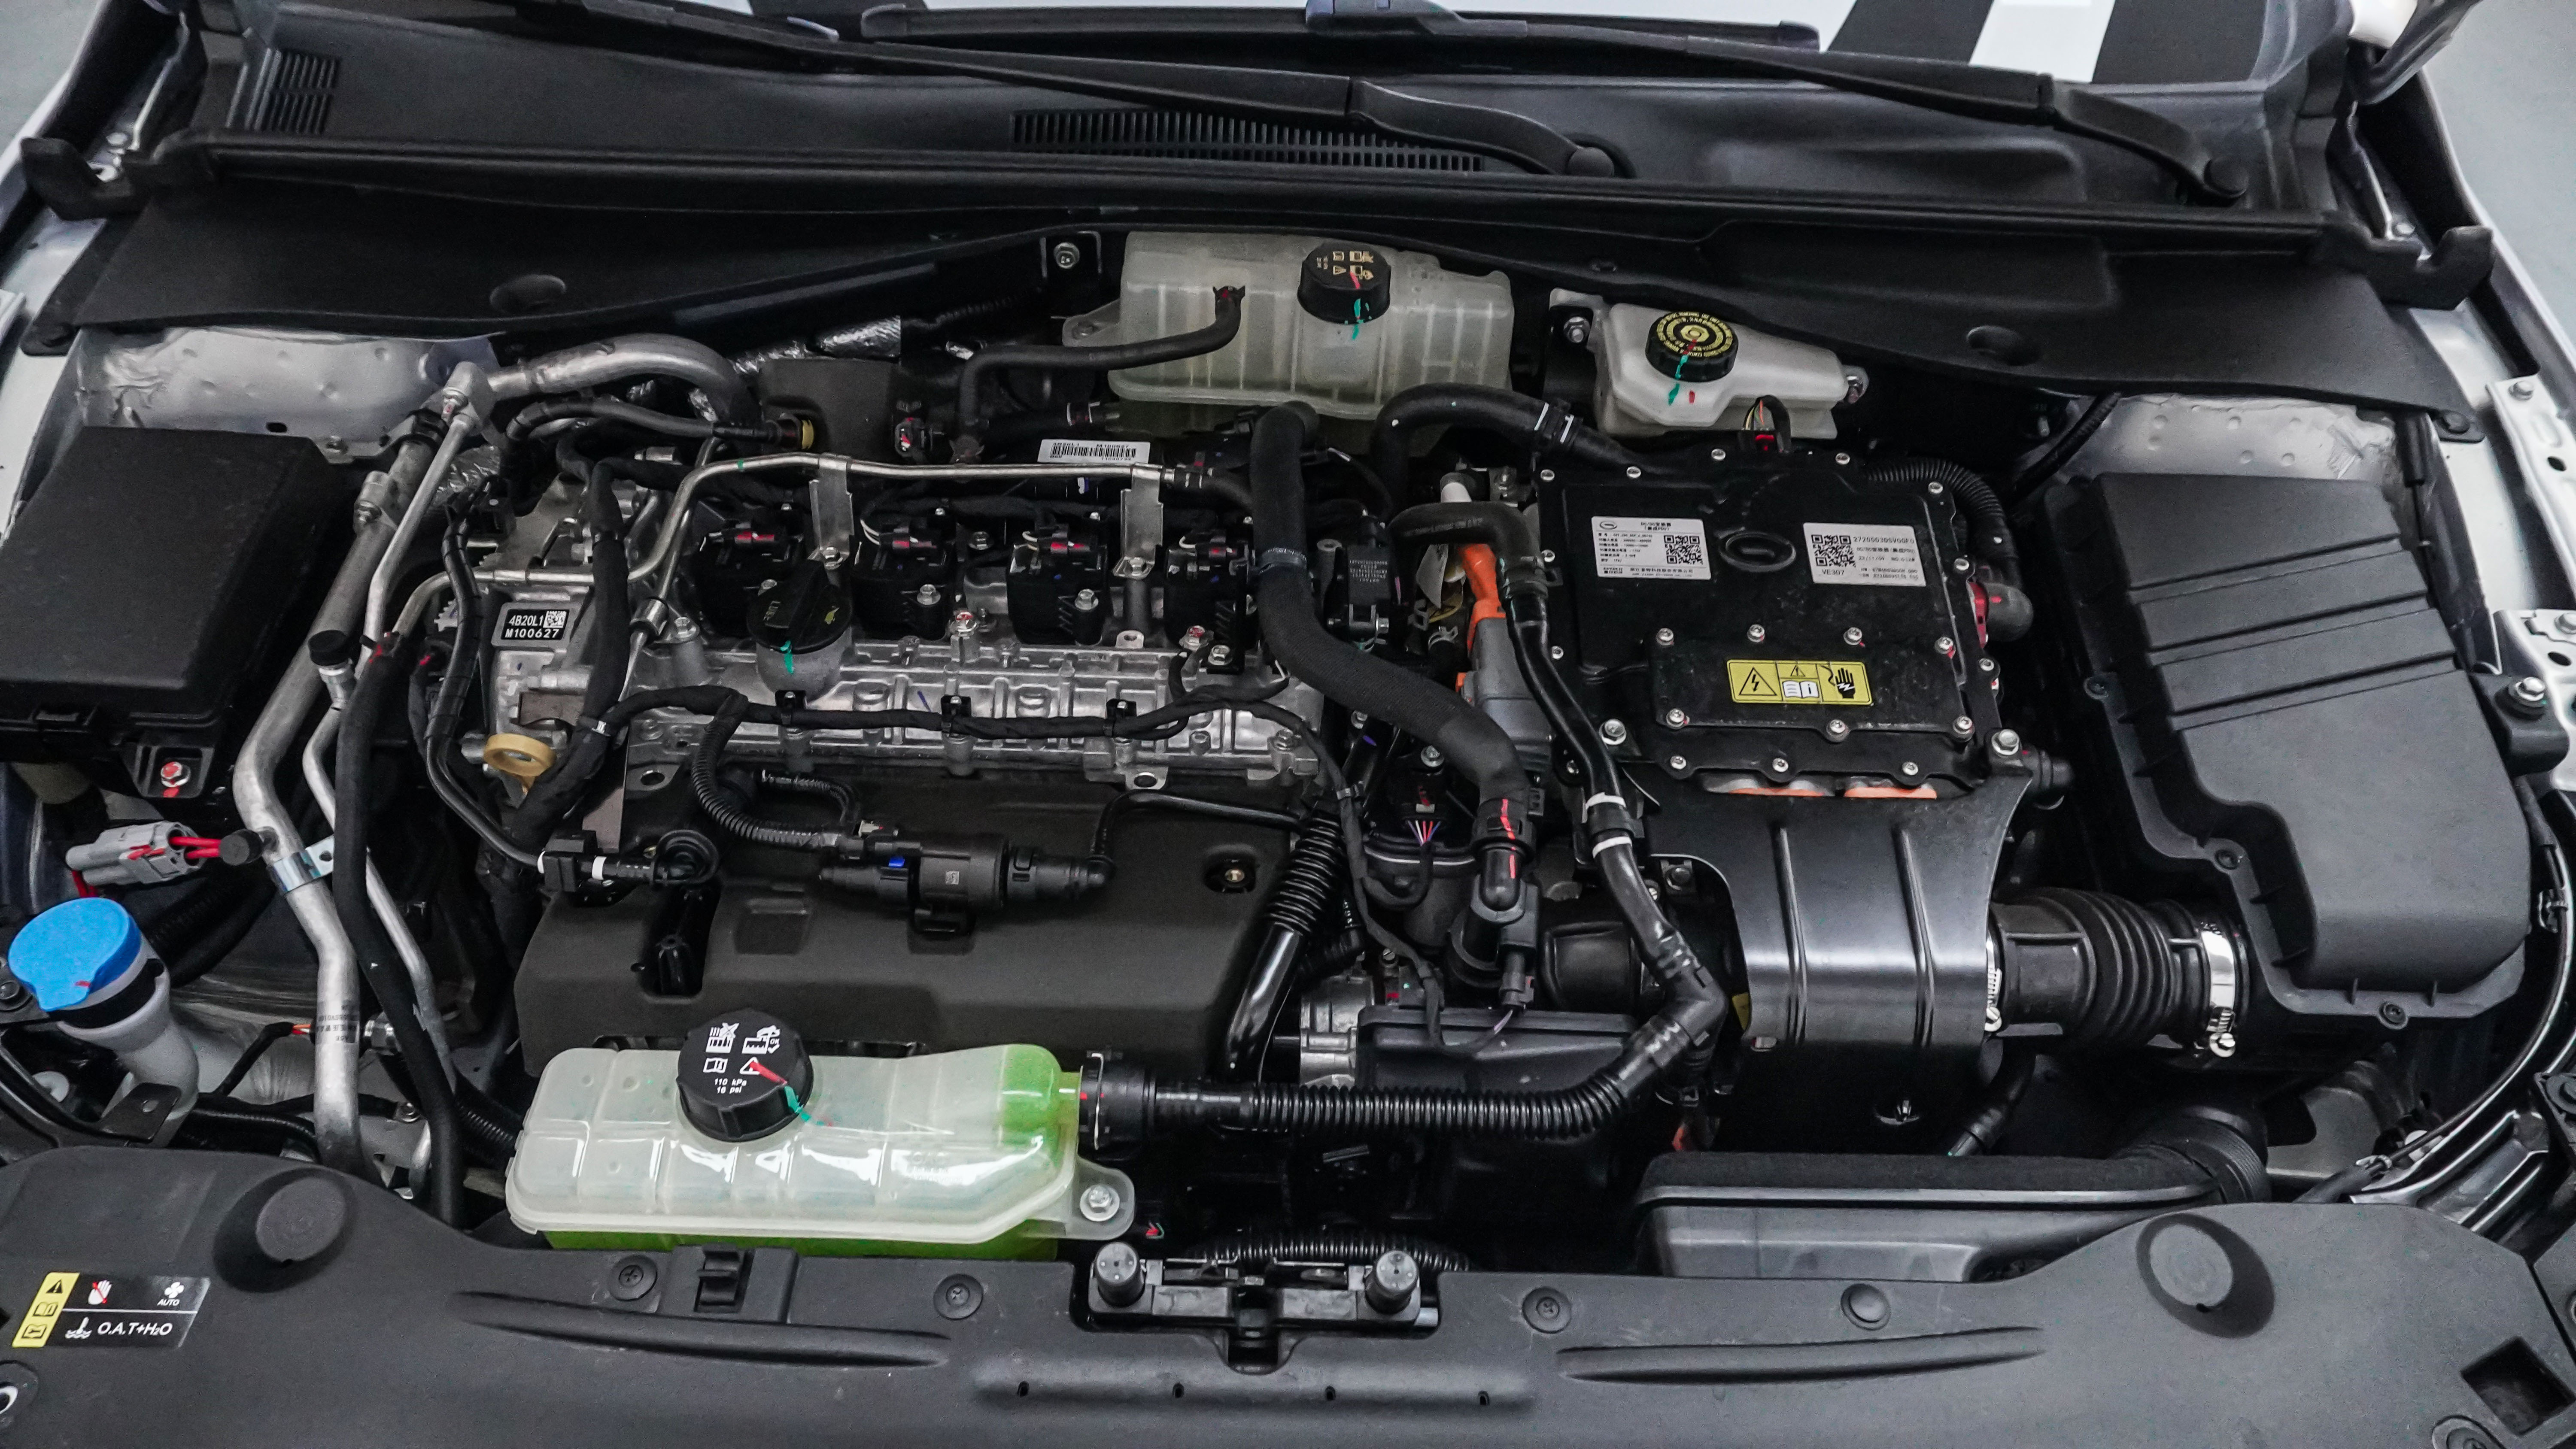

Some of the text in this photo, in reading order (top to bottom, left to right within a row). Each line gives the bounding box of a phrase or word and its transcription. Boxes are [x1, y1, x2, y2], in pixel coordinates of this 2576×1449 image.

[508, 615, 544, 626] 4B20L1
[504, 628, 559, 638] M100627
[714, 1078, 747, 1086] 110 kPa
[729, 1086, 742, 1094] psi
[156, 1298, 180, 1307] AUTO
